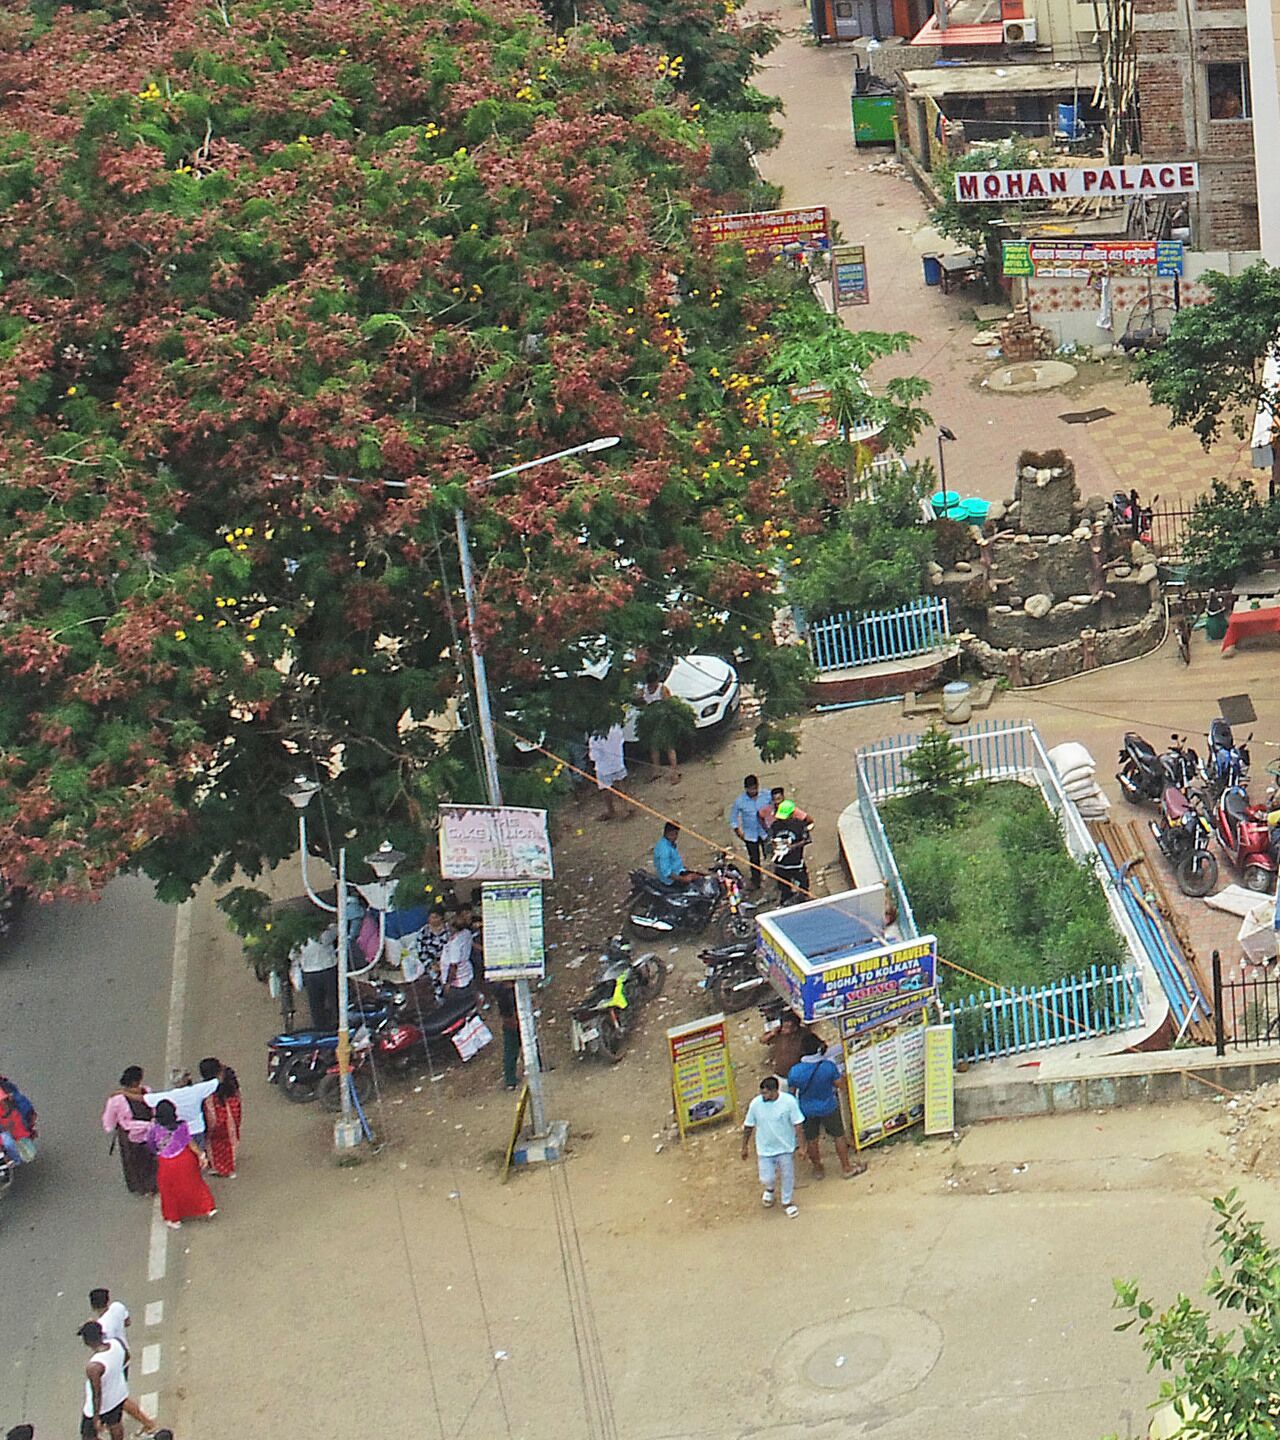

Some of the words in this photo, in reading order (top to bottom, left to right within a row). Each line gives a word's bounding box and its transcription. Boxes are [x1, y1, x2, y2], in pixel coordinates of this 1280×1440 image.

[958, 171, 1068, 199] MOHAN
[1083, 166, 1196, 192] PALACE
[822, 964, 853, 984] ROYAL
[854, 957, 881, 974] TOUR
[889, 943, 931, 962] TRAVELS
[826, 976, 858, 992] DIGHA
[861, 971, 874, 983] TO
[874, 958, 920, 978] KOLKATA
